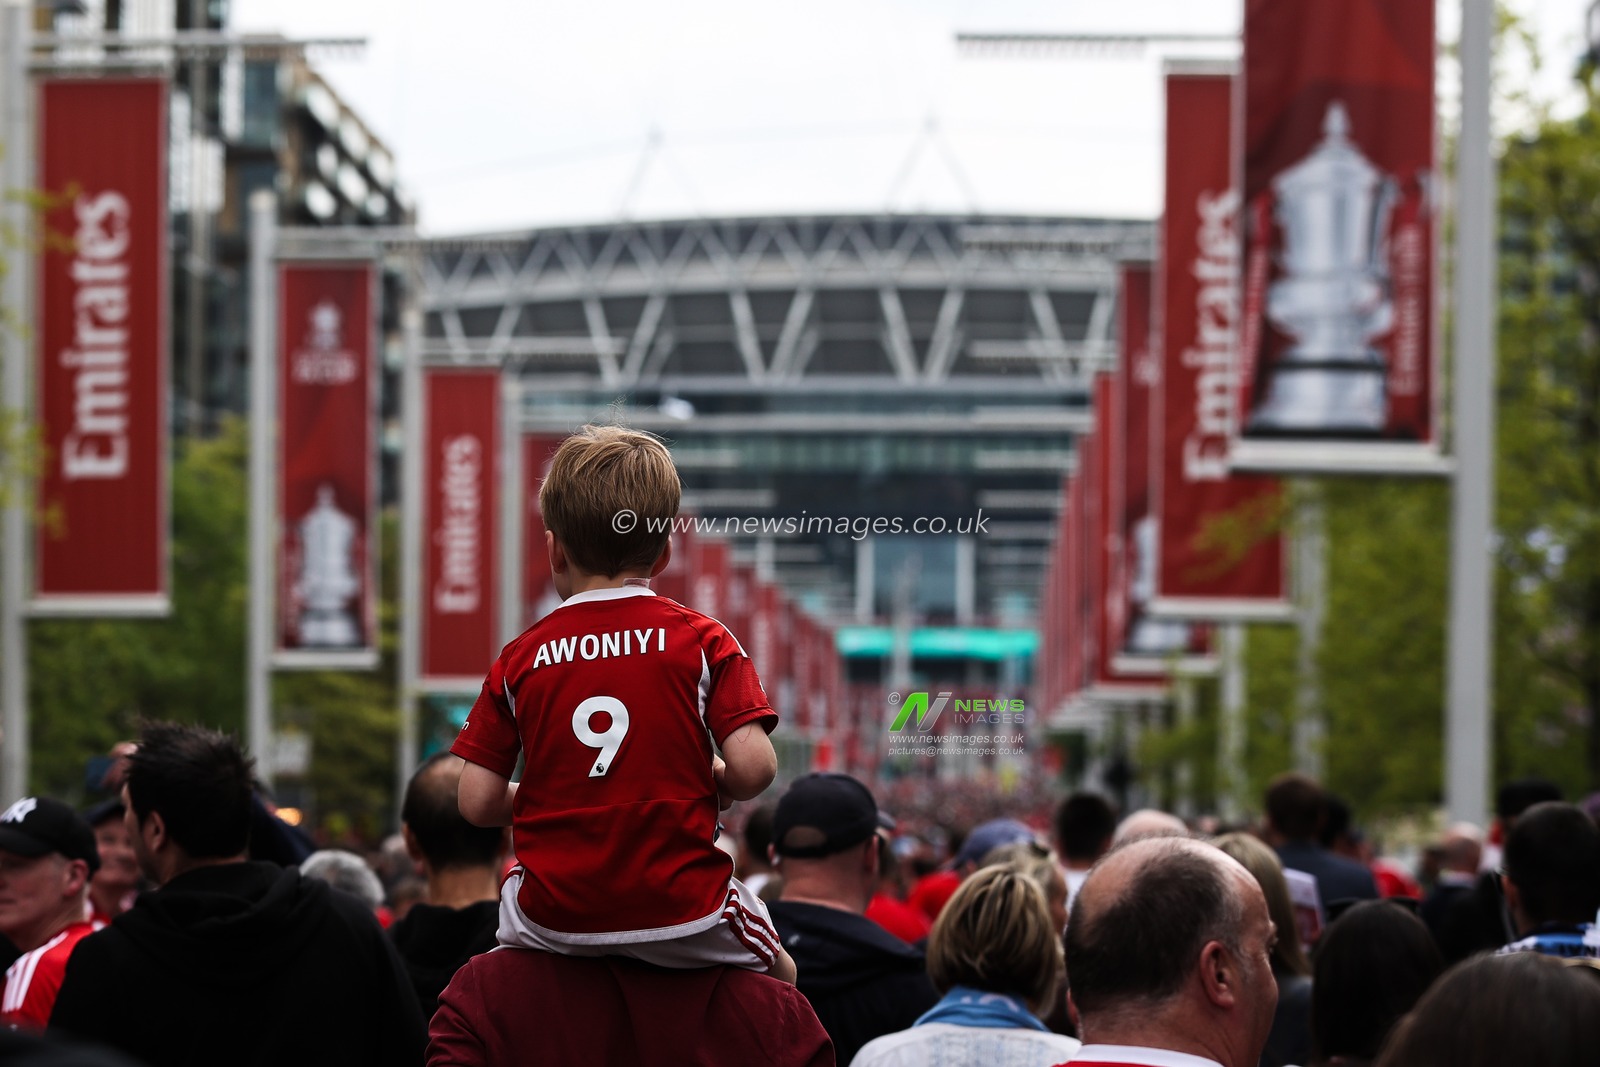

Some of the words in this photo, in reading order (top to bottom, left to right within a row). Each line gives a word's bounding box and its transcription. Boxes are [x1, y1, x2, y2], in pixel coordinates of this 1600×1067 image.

[62, 190, 130, 481] Emirates
[533, 627, 666, 669] AWONIYI
[571, 695, 630, 778] 9
